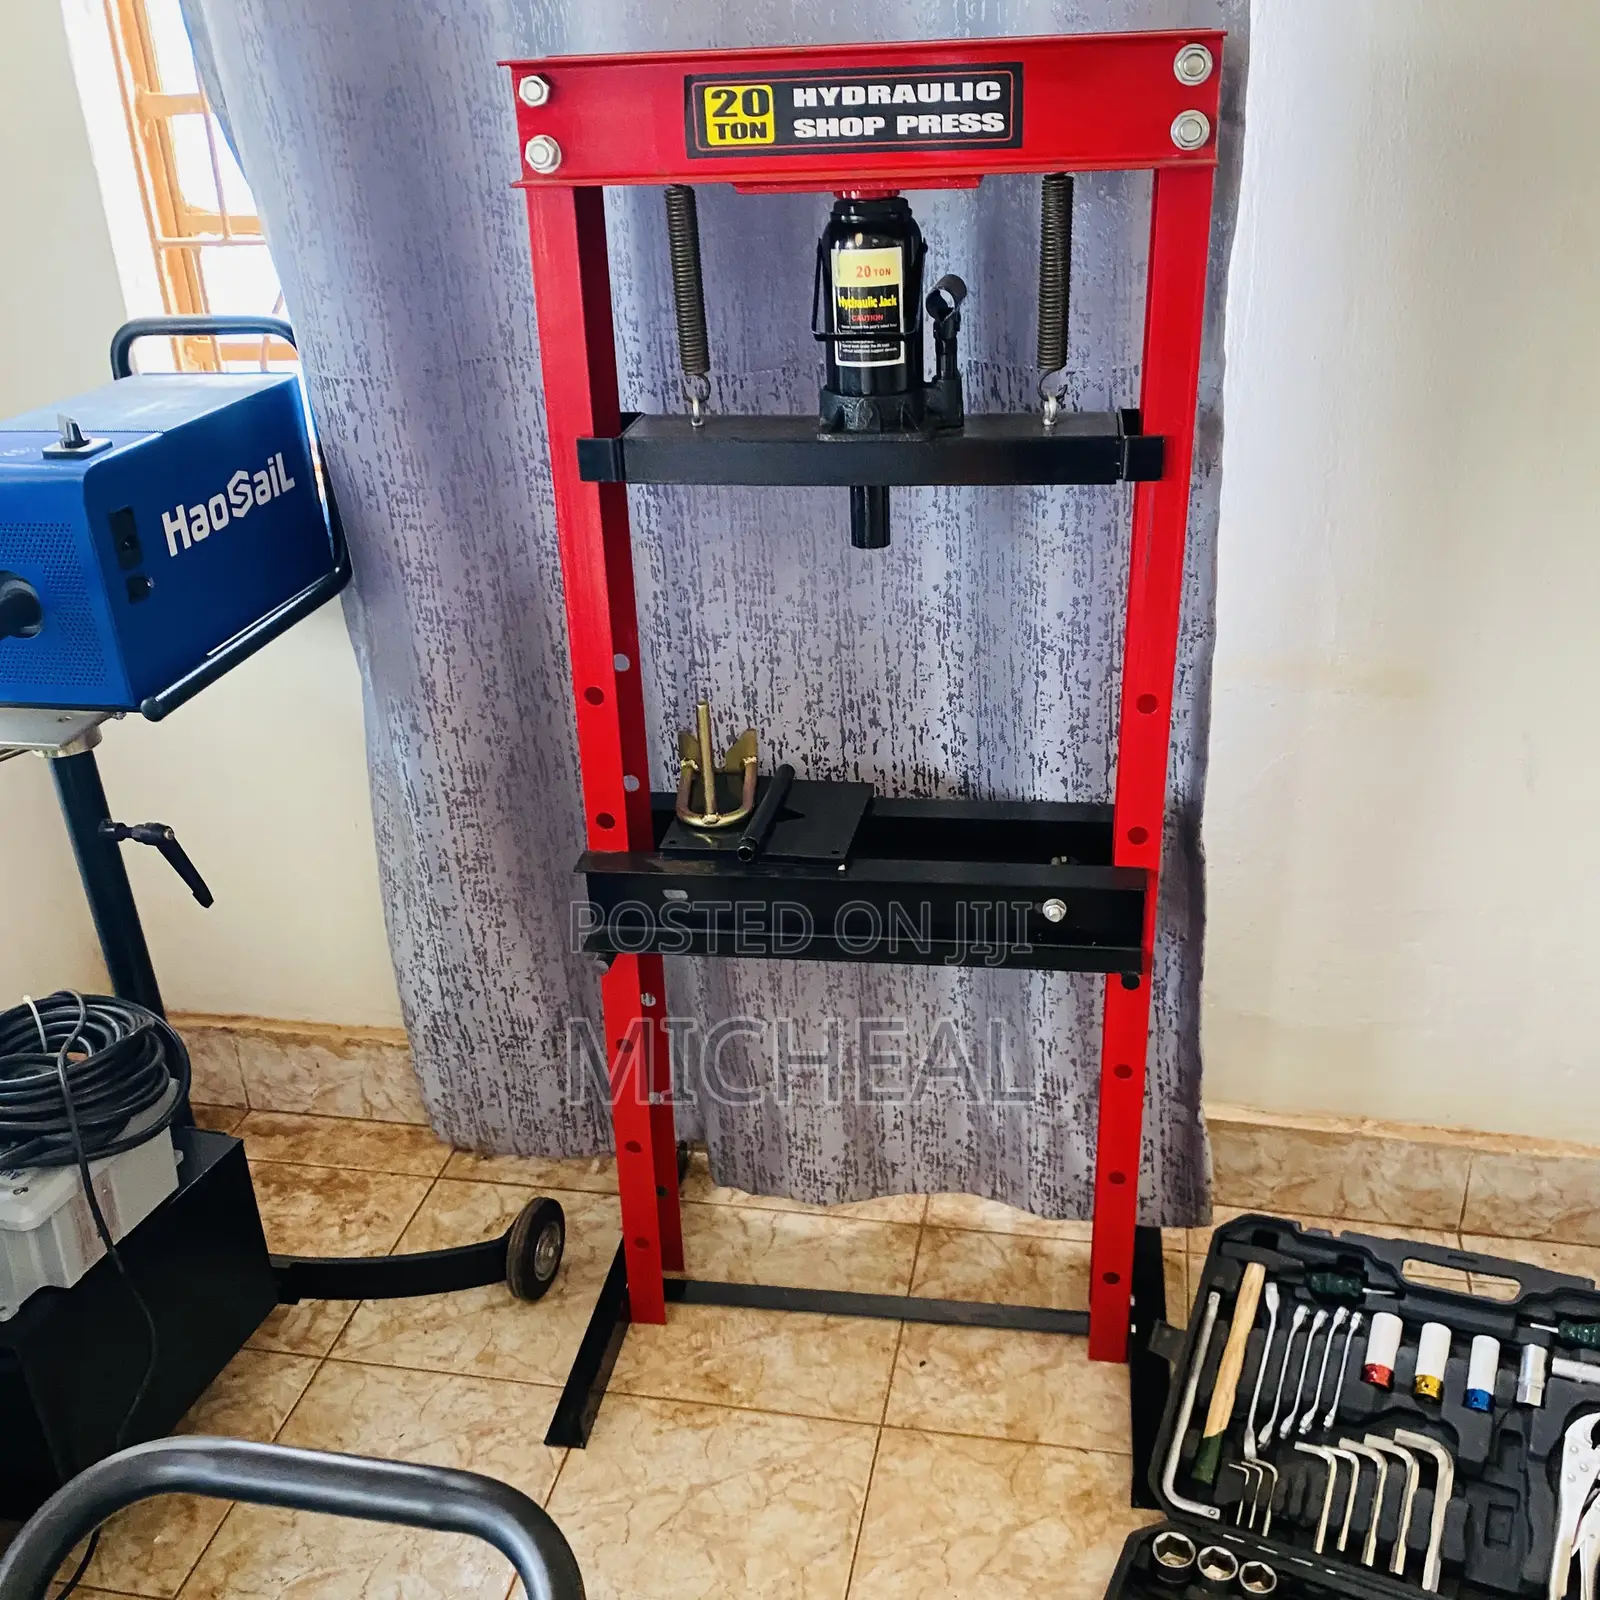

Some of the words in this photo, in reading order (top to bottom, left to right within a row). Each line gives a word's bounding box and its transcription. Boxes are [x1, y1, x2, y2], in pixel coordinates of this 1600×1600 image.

[710, 88, 770, 118] 20
[793, 81, 1001, 107] HYDRAULIC
[713, 121, 768, 140] TON
[793, 116, 885, 138] SHOP
[897, 112, 1005, 135] PRESS
[855, 265, 872, 278] 20
[874, 268, 892, 276] TON
[838, 295, 878, 310] Hydraulic
[879, 294, 897, 307] Jack
[851, 314, 884, 322] CAUTION
